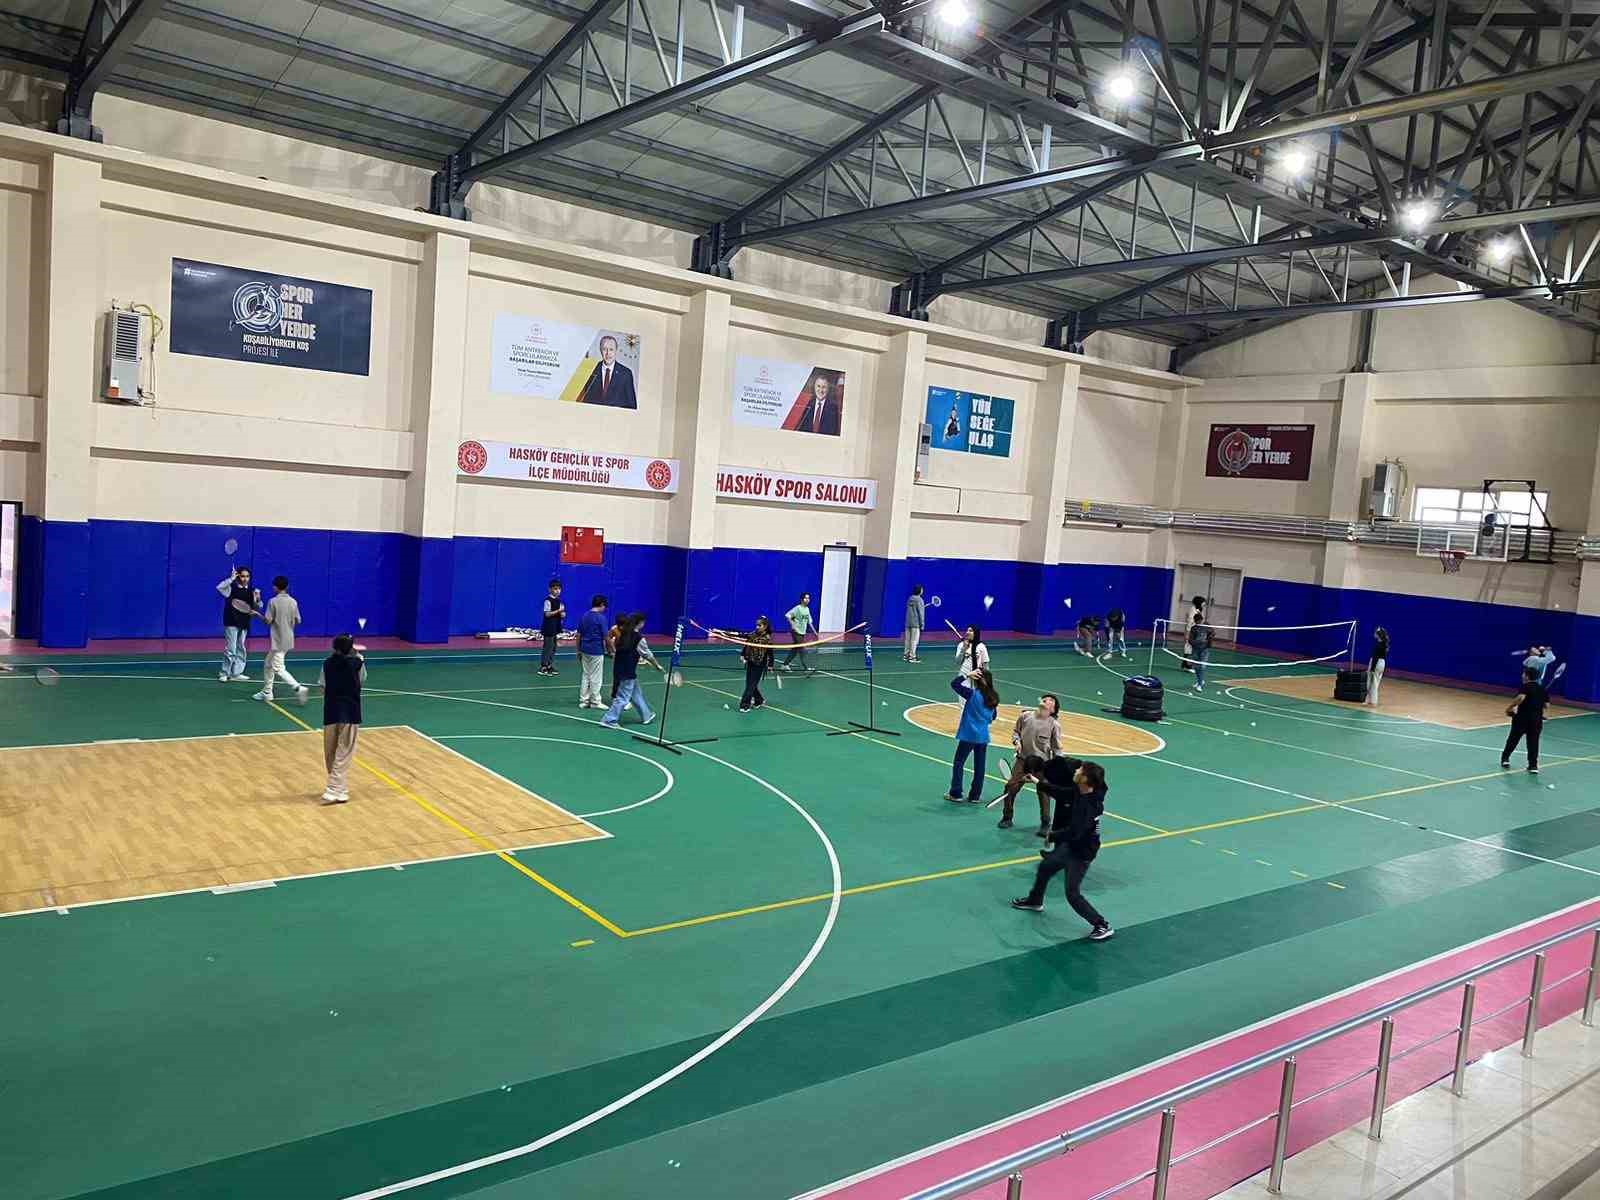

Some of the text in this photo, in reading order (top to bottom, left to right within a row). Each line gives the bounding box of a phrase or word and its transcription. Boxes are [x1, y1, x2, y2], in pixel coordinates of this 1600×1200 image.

[280, 284, 314, 304] SPOR
[280, 320, 317, 340] YERDE
[296, 341, 310, 353] KOŞ
[972, 397, 992, 416] YÜK
[969, 415, 996, 432] SEĞE
[968, 431, 995, 450] ULAŞ
[509, 447, 630, 470] HASKÖY GENÇLİK VE SPOR
[1264, 451, 1292, 465] YERDE
[528, 463, 611, 484] İLÇE MÜDÜRLÜĞÜ
[716, 472, 867, 505] HASKÖY SPOR SALONU
